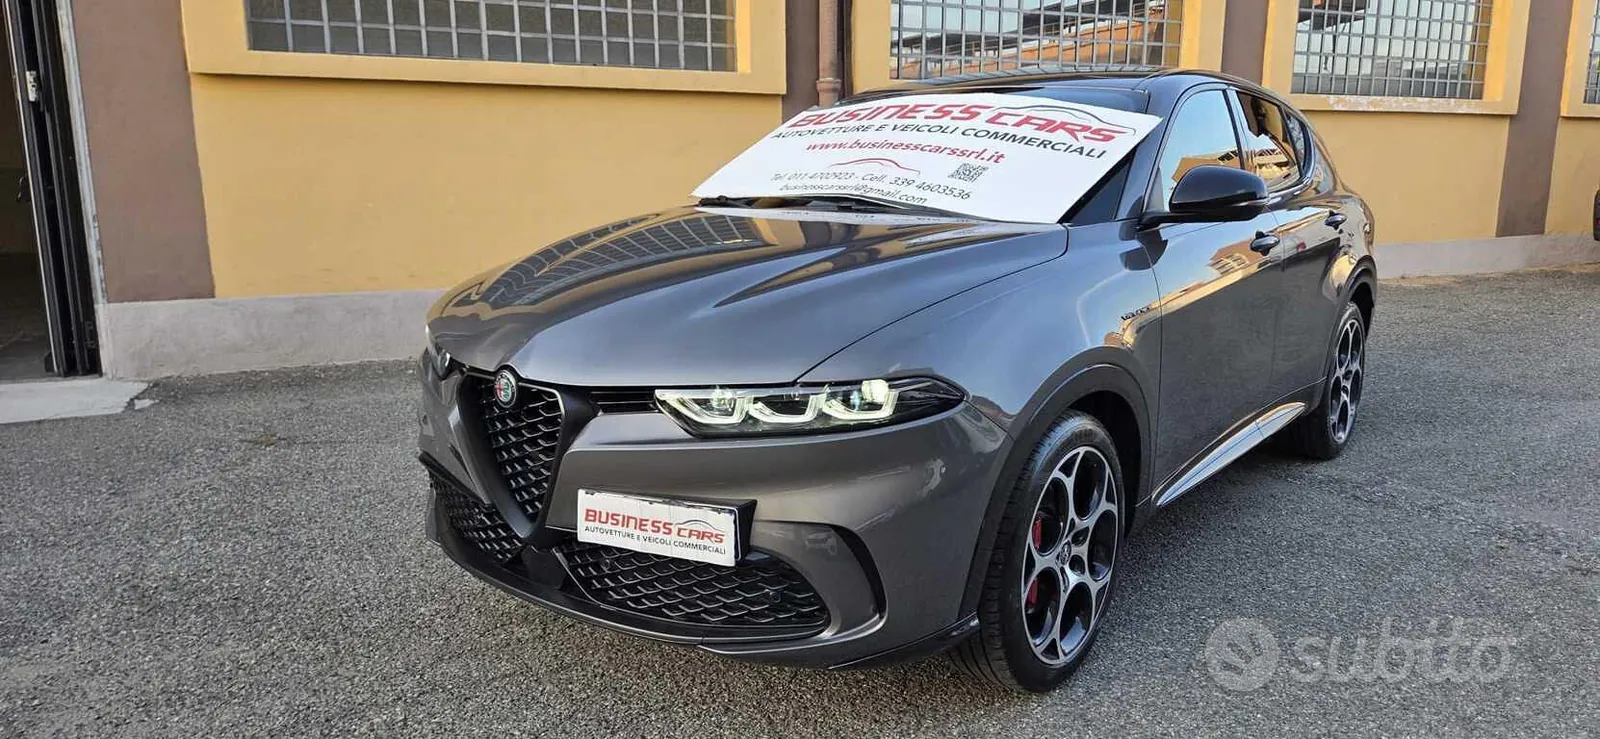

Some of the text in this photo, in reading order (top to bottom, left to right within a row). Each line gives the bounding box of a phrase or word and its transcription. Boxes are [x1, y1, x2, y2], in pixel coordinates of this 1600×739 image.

[788, 104, 1126, 143] BUSINESS CARS
[772, 125, 874, 139] AUTOVETTURE
[892, 124, 959, 135] VEICOLI
[961, 125, 1106, 159] COMMERCIALI
[806, 139, 1005, 164] www.businesscarssrl.it
[889, 176, 915, 188] 339
[916, 181, 970, 200] 4603536
[584, 525, 636, 541] AUTOVETTURE
[643, 536, 672, 546] VEICOLI
[673, 540, 726, 555] COMMERCIALI
[585, 508, 725, 544] BUSINESS CARS
